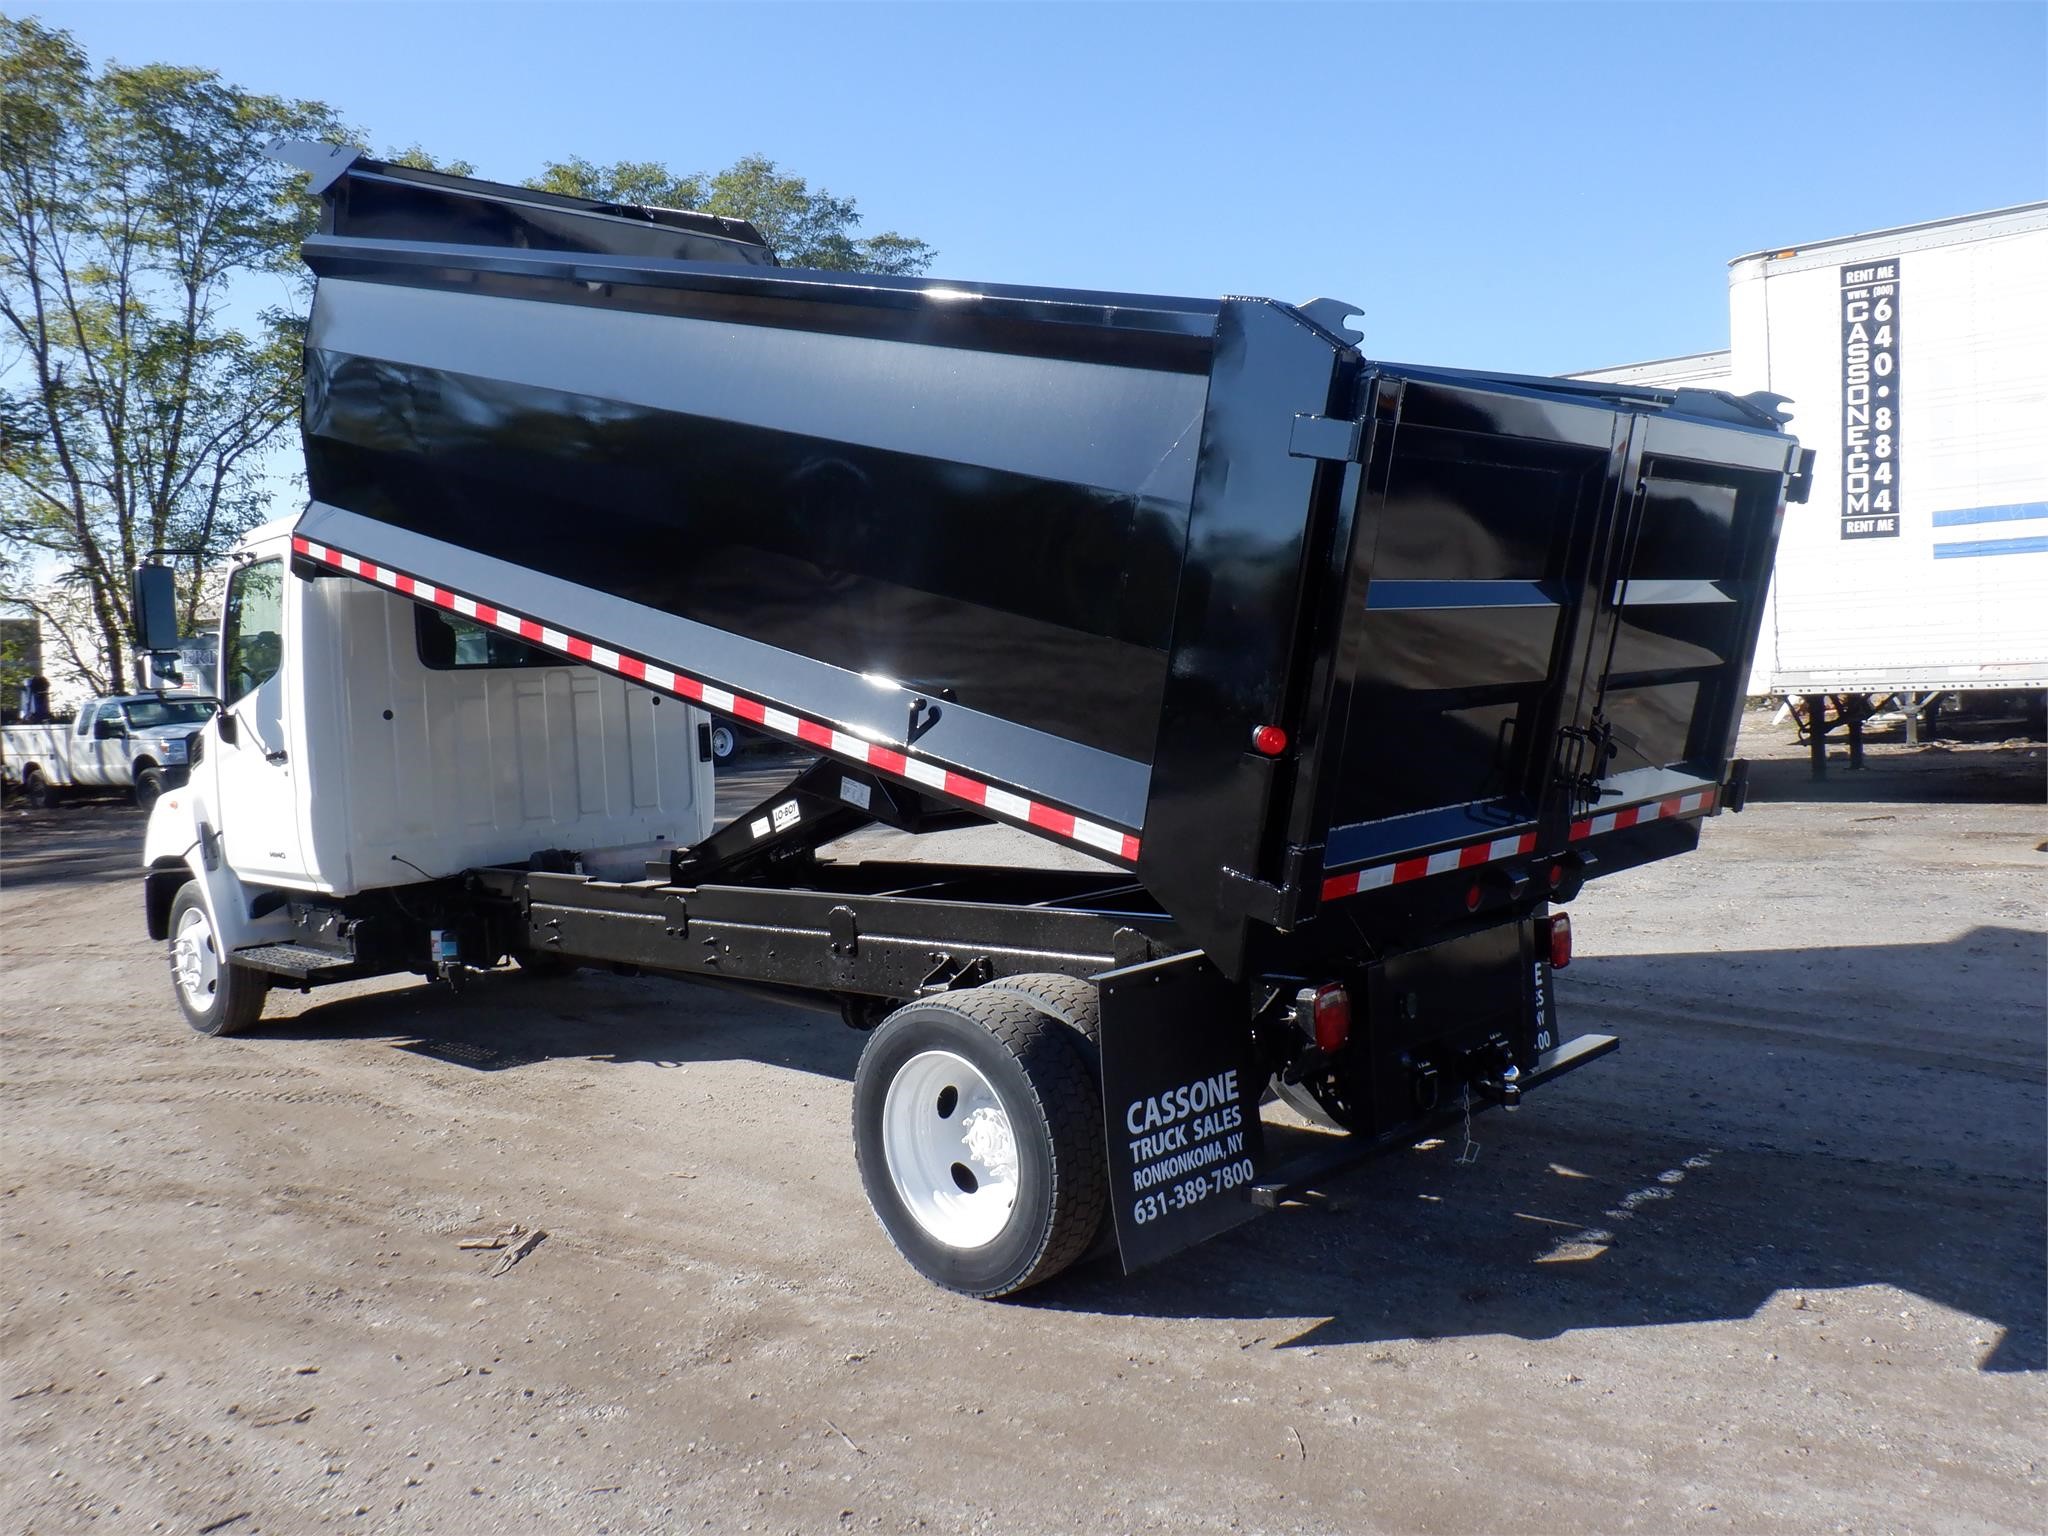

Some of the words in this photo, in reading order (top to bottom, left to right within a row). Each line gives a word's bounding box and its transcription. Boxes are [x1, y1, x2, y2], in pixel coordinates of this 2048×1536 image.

[1846, 268, 1875, 284] RENT
[1877, 265, 1894, 279] ME
[1873, 284, 1894, 297] (800)
[1846, 520, 1875, 533] RENT
[1877, 518, 1894, 531] ME
[775, 802, 797, 821] LO-BOY
[1126, 1069, 1240, 1135] CASSONE
[1129, 1124, 1188, 1164] TRUCK
[1192, 1105, 1243, 1141] SALES
[1132, 1140, 1227, 1192] RONKONKOMA,
[1227, 1131, 1244, 1155] NY
[1134, 1158, 1254, 1225] 631-389-7800
